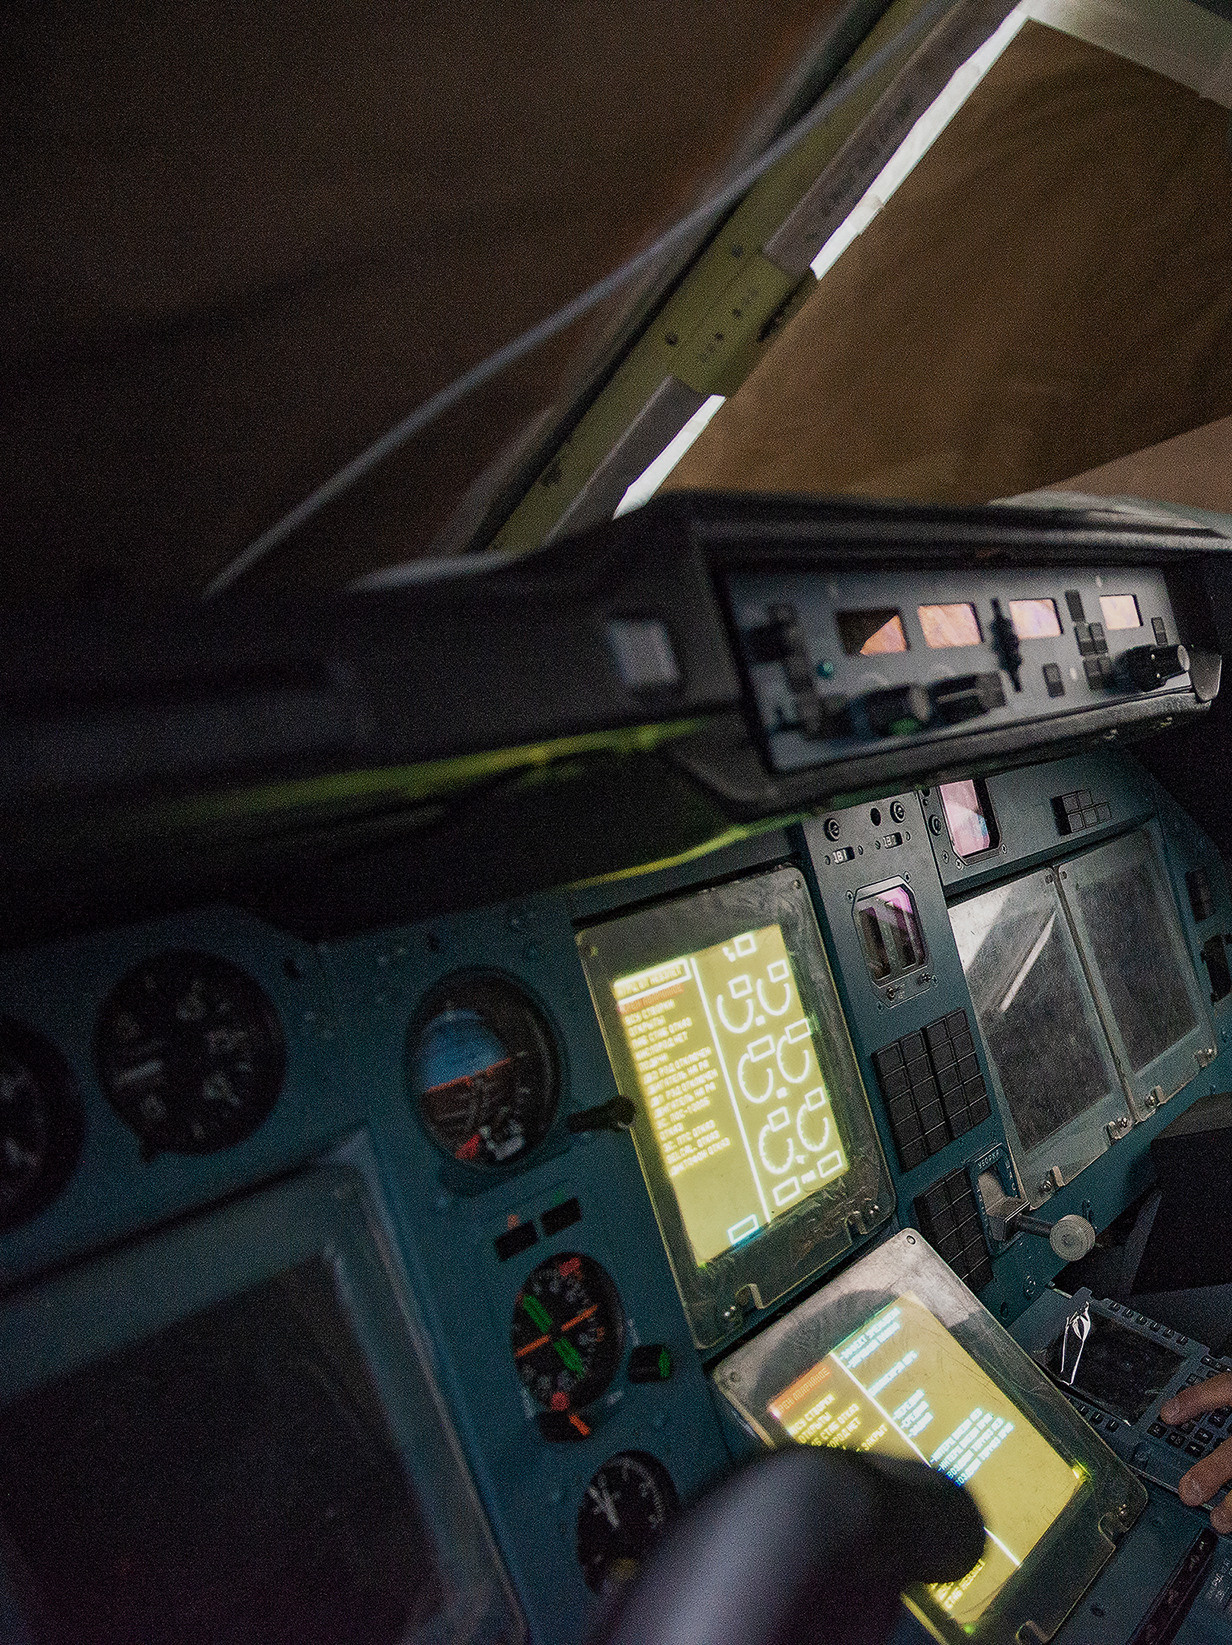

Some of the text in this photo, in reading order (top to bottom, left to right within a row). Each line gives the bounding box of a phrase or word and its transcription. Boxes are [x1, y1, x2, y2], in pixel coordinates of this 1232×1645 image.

[803, 1392, 835, 1422] СТВОРКИ
[836, 1402, 860, 1425] ОТКАЗ
[797, 1410, 833, 1444] ОТКРЫТЫ
